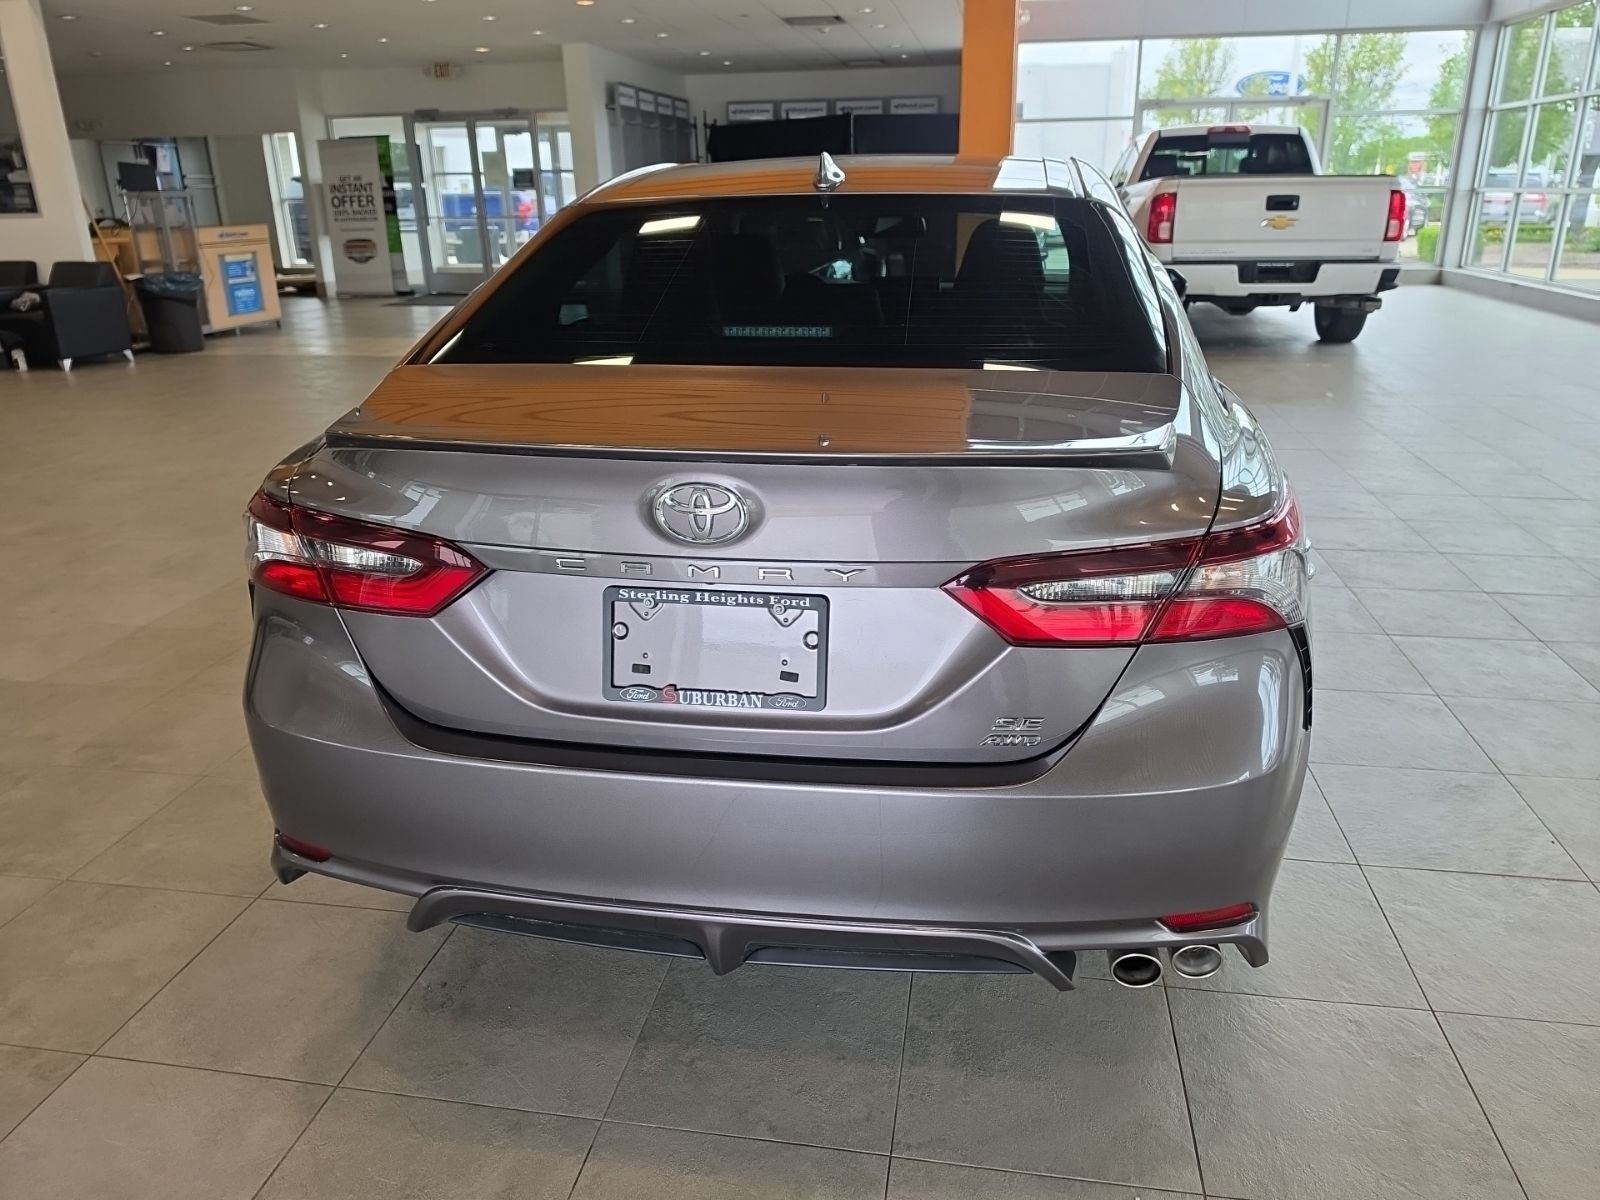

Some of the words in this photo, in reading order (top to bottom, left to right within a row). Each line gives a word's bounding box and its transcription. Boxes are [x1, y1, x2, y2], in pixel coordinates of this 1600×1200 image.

[434, 63, 449, 78] EXIT
[329, 183, 373, 194] INSTANT
[331, 195, 375, 208] OFFER
[555, 557, 867, 582] CAMRY
[618, 588, 691, 604] Sterling
[694, 591, 764, 606] Heights
[768, 595, 810, 607] Ford
[626, 688, 650, 701] Ford
[662, 685, 764, 708] SUBURBAN
[775, 696, 799, 708] Ford
[991, 716, 1046, 731] SE
[978, 732, 1041, 747] AWD
